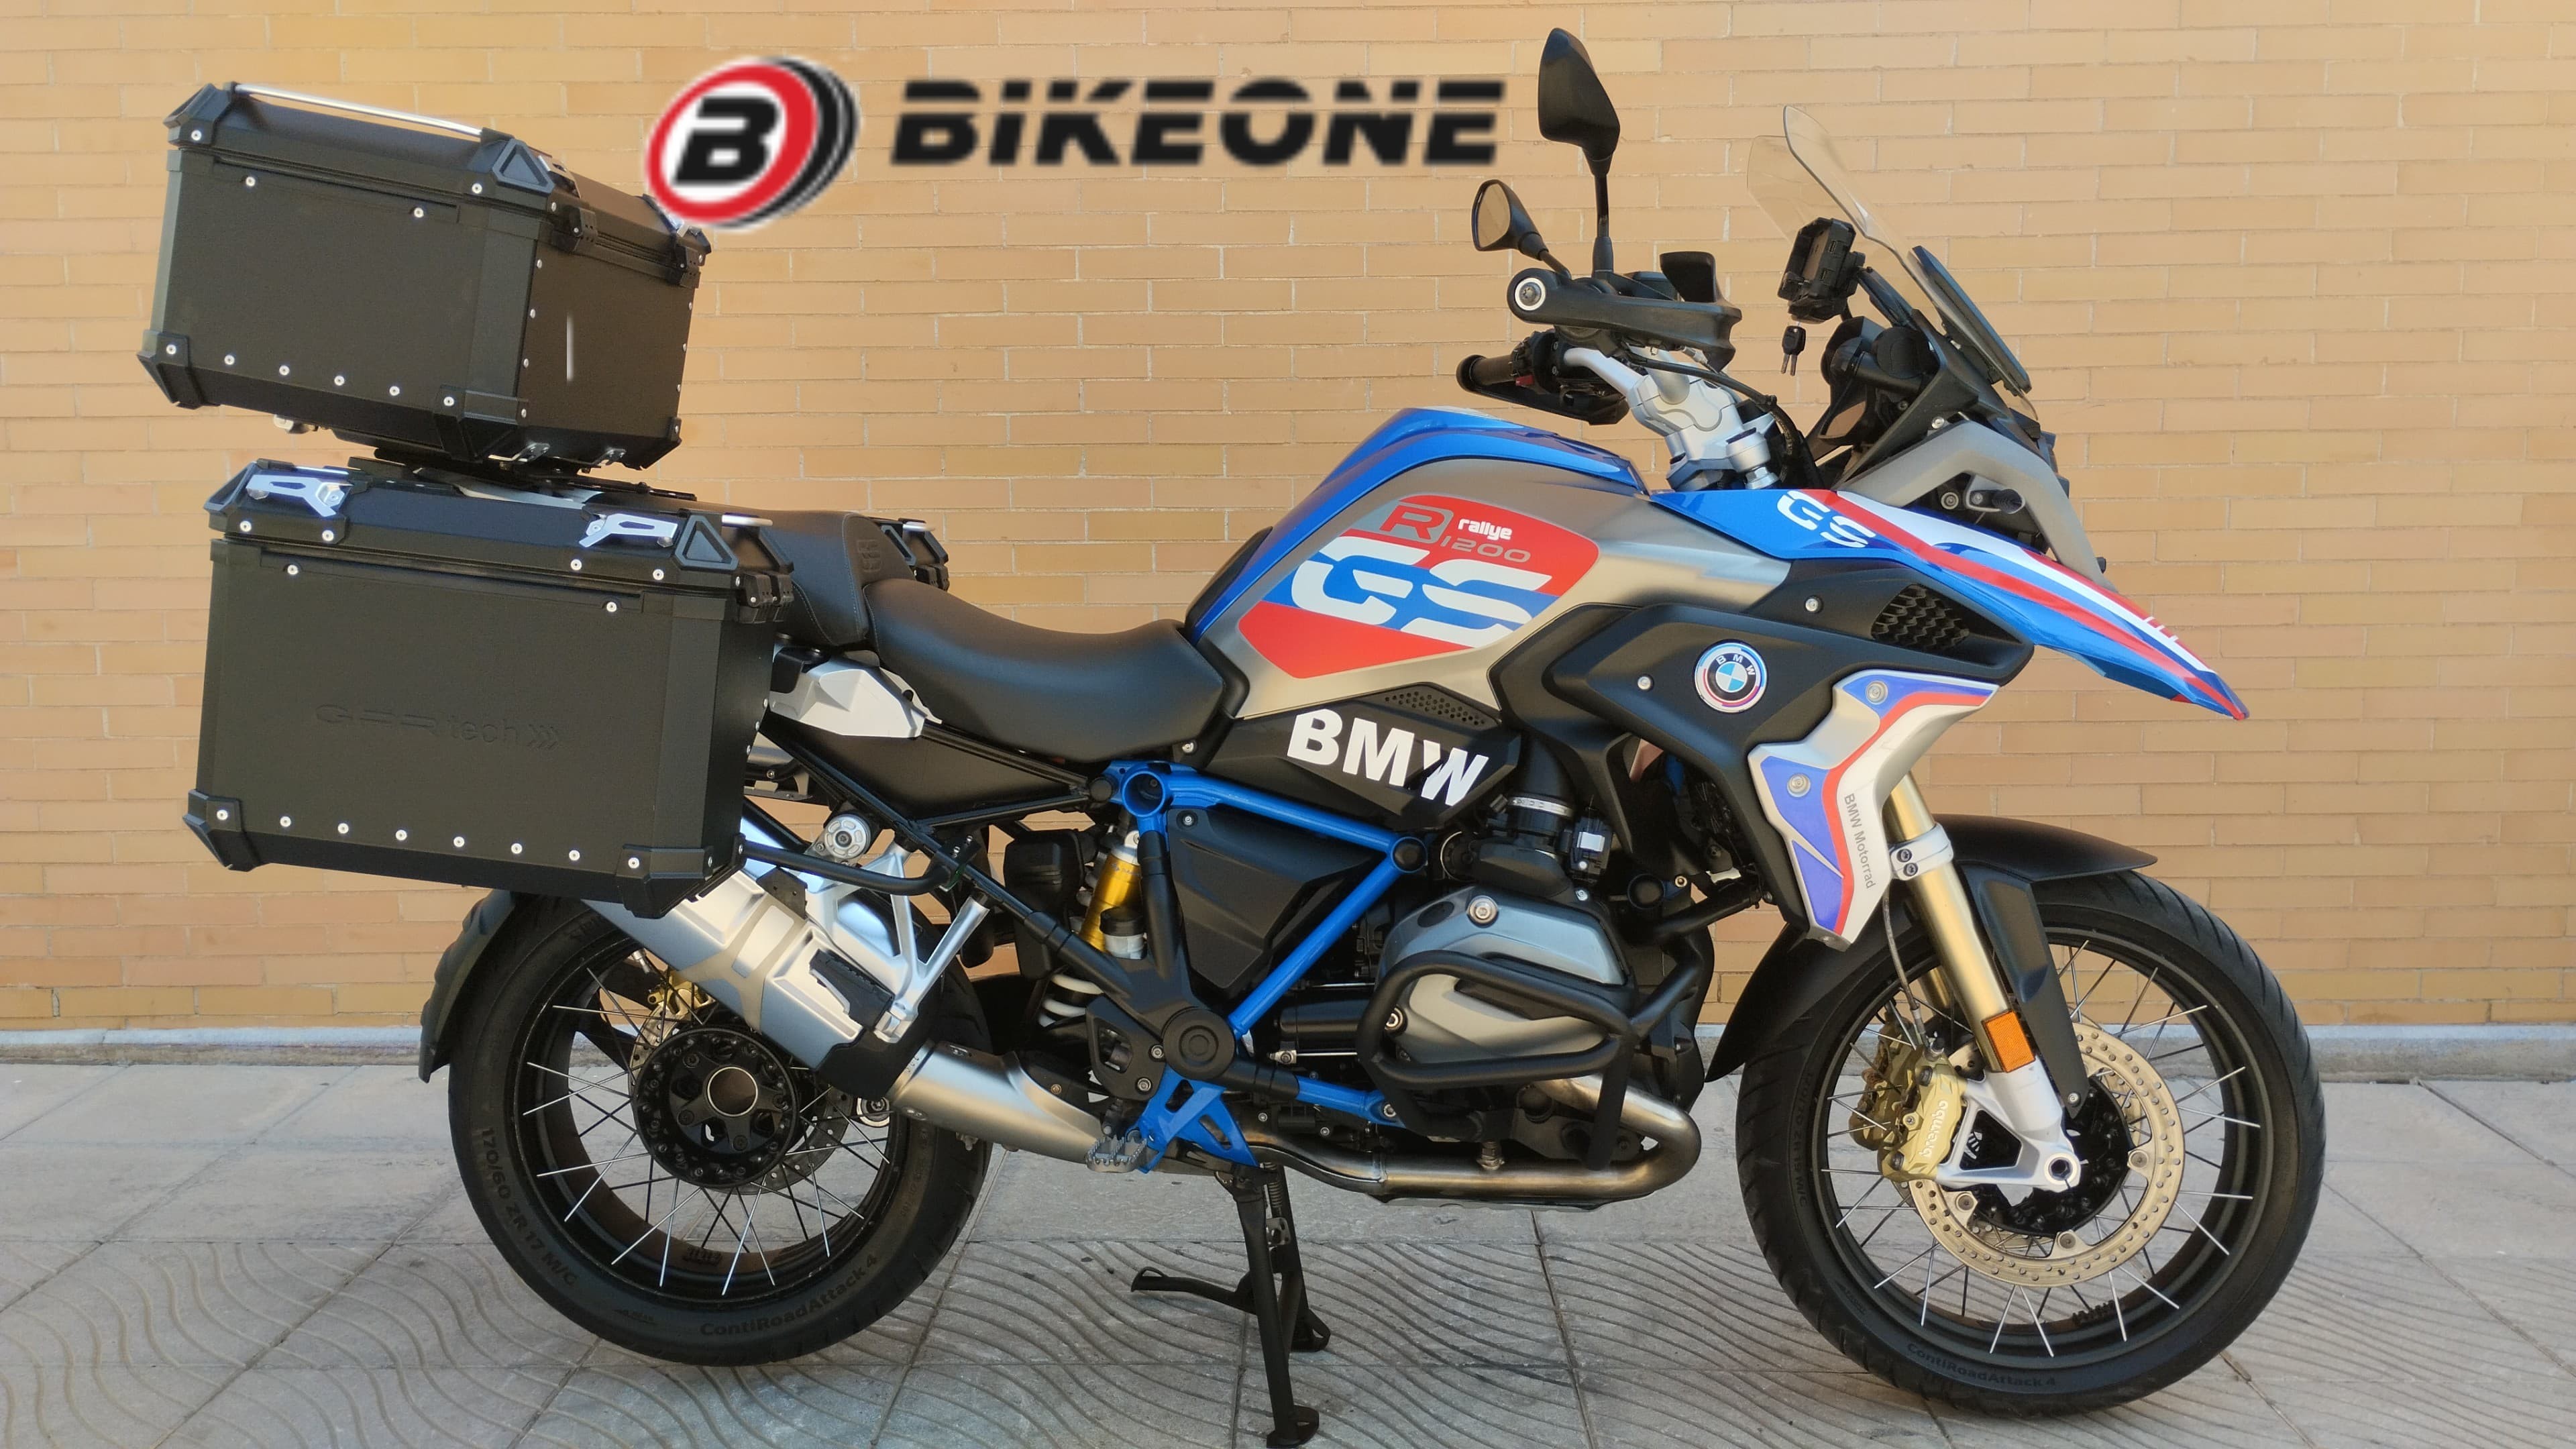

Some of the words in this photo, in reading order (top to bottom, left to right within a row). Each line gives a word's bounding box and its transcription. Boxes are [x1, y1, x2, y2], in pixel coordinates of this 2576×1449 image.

[1379, 504, 1445, 540] R
[1458, 518, 1513, 541] rallye
[1777, 490, 1876, 547] GS
[1440, 535, 1531, 562] 1200
[1291, 536, 1552, 648] GS
[1716, 653, 1756, 676] BMW
[1287, 708, 1489, 807] BMW
[1844, 793, 1862, 828] BMW
[1854, 830, 1876, 889] Motorrad
[1919, 1099, 1949, 1158] brembo
[482, 1126, 512, 1199] 170/60
[700, 1266, 865, 1336] ContiRoadAttack
[866, 1253, 878, 1268] 4
[1907, 1342, 2043, 1387] ContiRoadAttack
